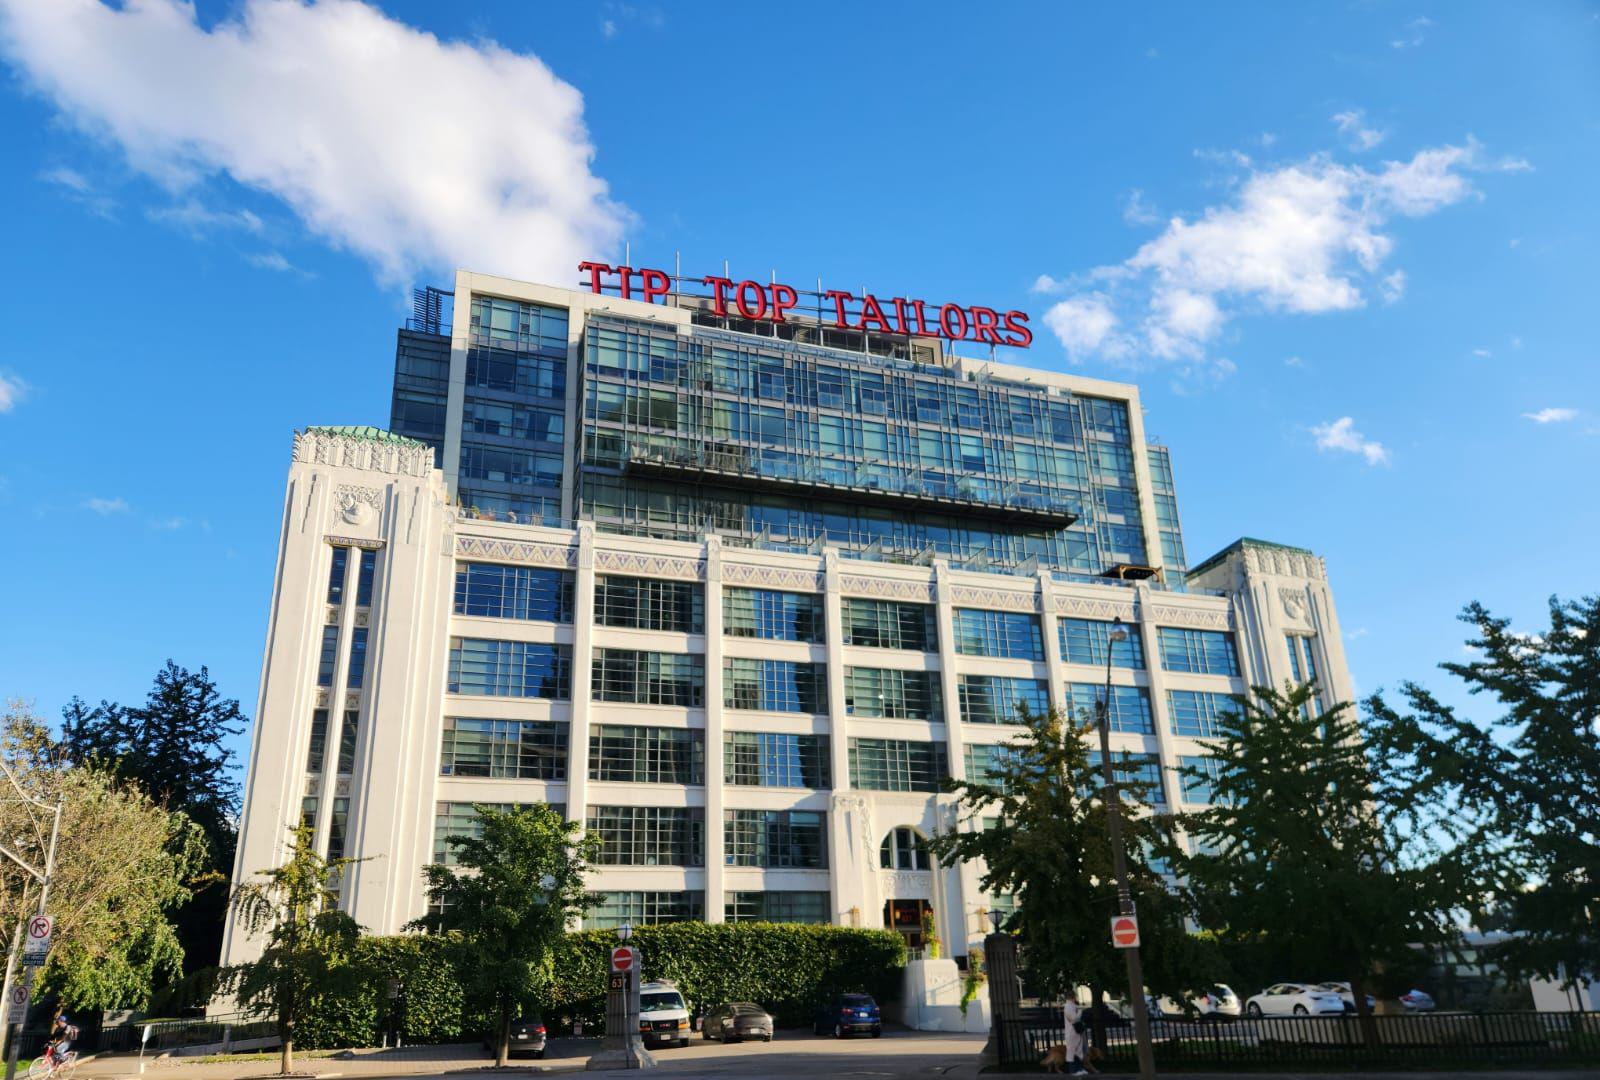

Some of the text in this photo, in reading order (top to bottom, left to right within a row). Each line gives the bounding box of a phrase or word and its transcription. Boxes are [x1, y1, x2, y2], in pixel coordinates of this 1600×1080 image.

[578, 261, 1032, 348] TIP TOP TAILORS
